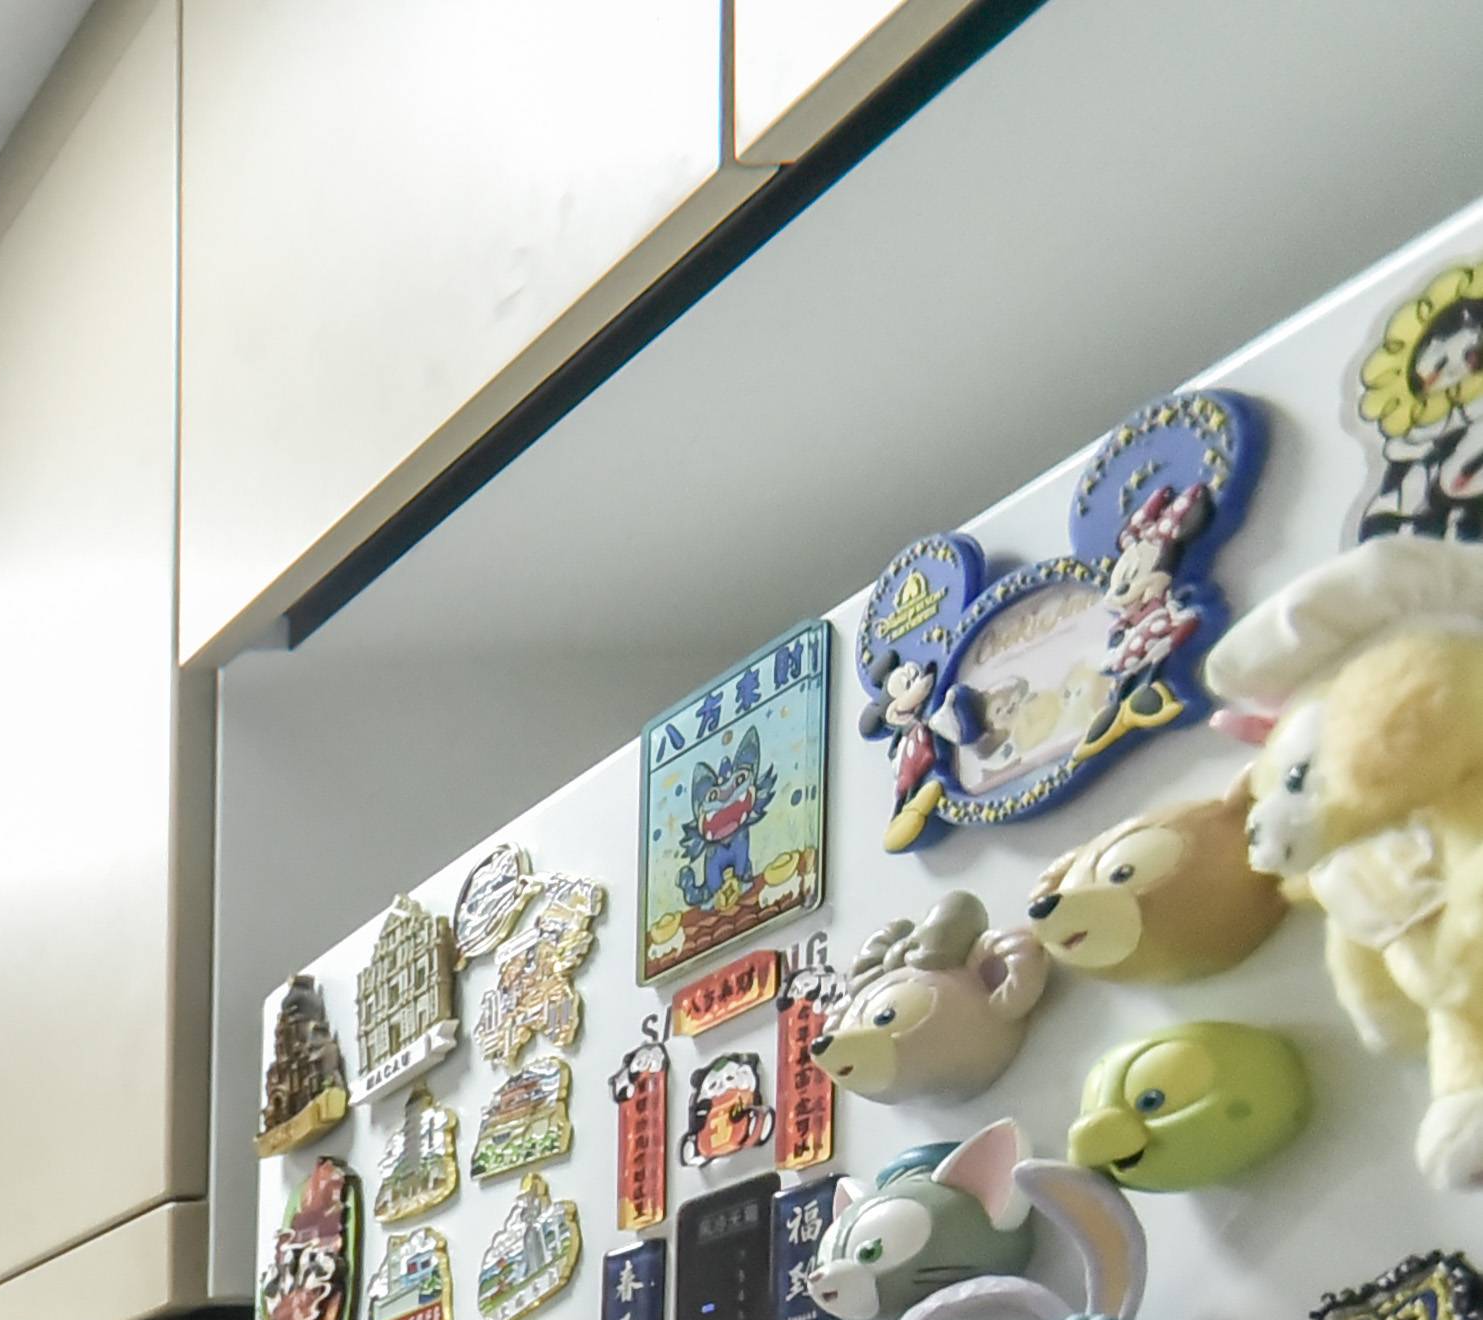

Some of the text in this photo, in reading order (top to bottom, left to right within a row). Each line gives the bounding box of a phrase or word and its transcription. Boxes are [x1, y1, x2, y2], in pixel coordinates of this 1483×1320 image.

[655, 640, 805, 763] 八方来财
[366, 1050, 412, 1091] MACAU
